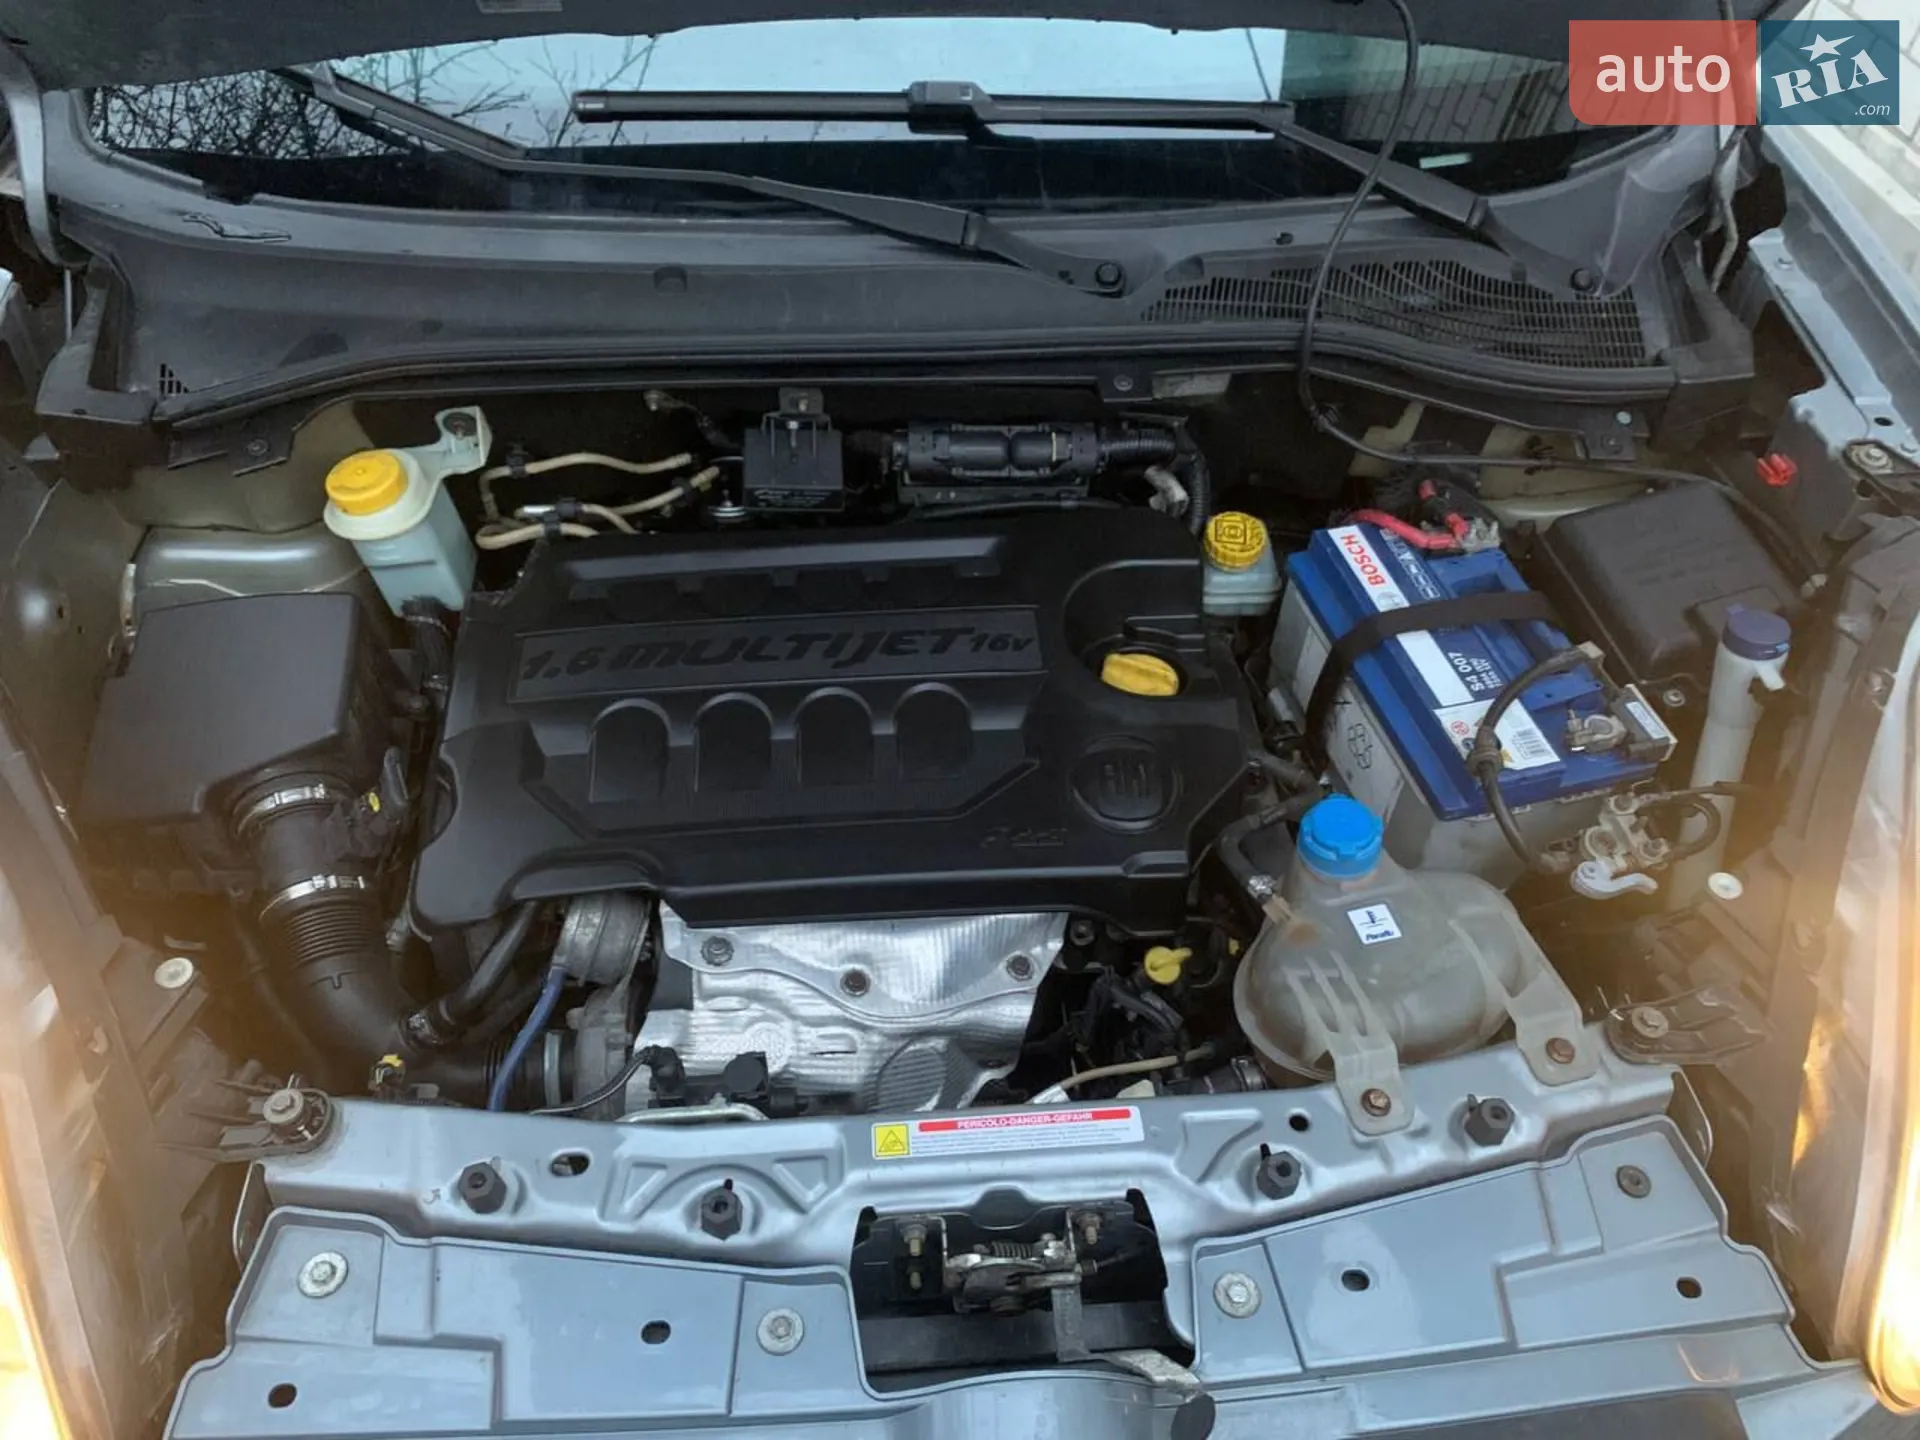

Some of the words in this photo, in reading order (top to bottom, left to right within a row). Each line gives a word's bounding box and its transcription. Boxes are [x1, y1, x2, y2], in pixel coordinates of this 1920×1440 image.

[1340, 533, 1386, 586] BOSCH
[522, 646, 604, 681] 1.6
[608, 627, 975, 670] MULTIJET
[1448, 652, 1472, 673] 007
[1465, 675, 1485, 691] S4
[957, 1111, 1093, 1129] PERICOLO-DANGER-GEFAHR
